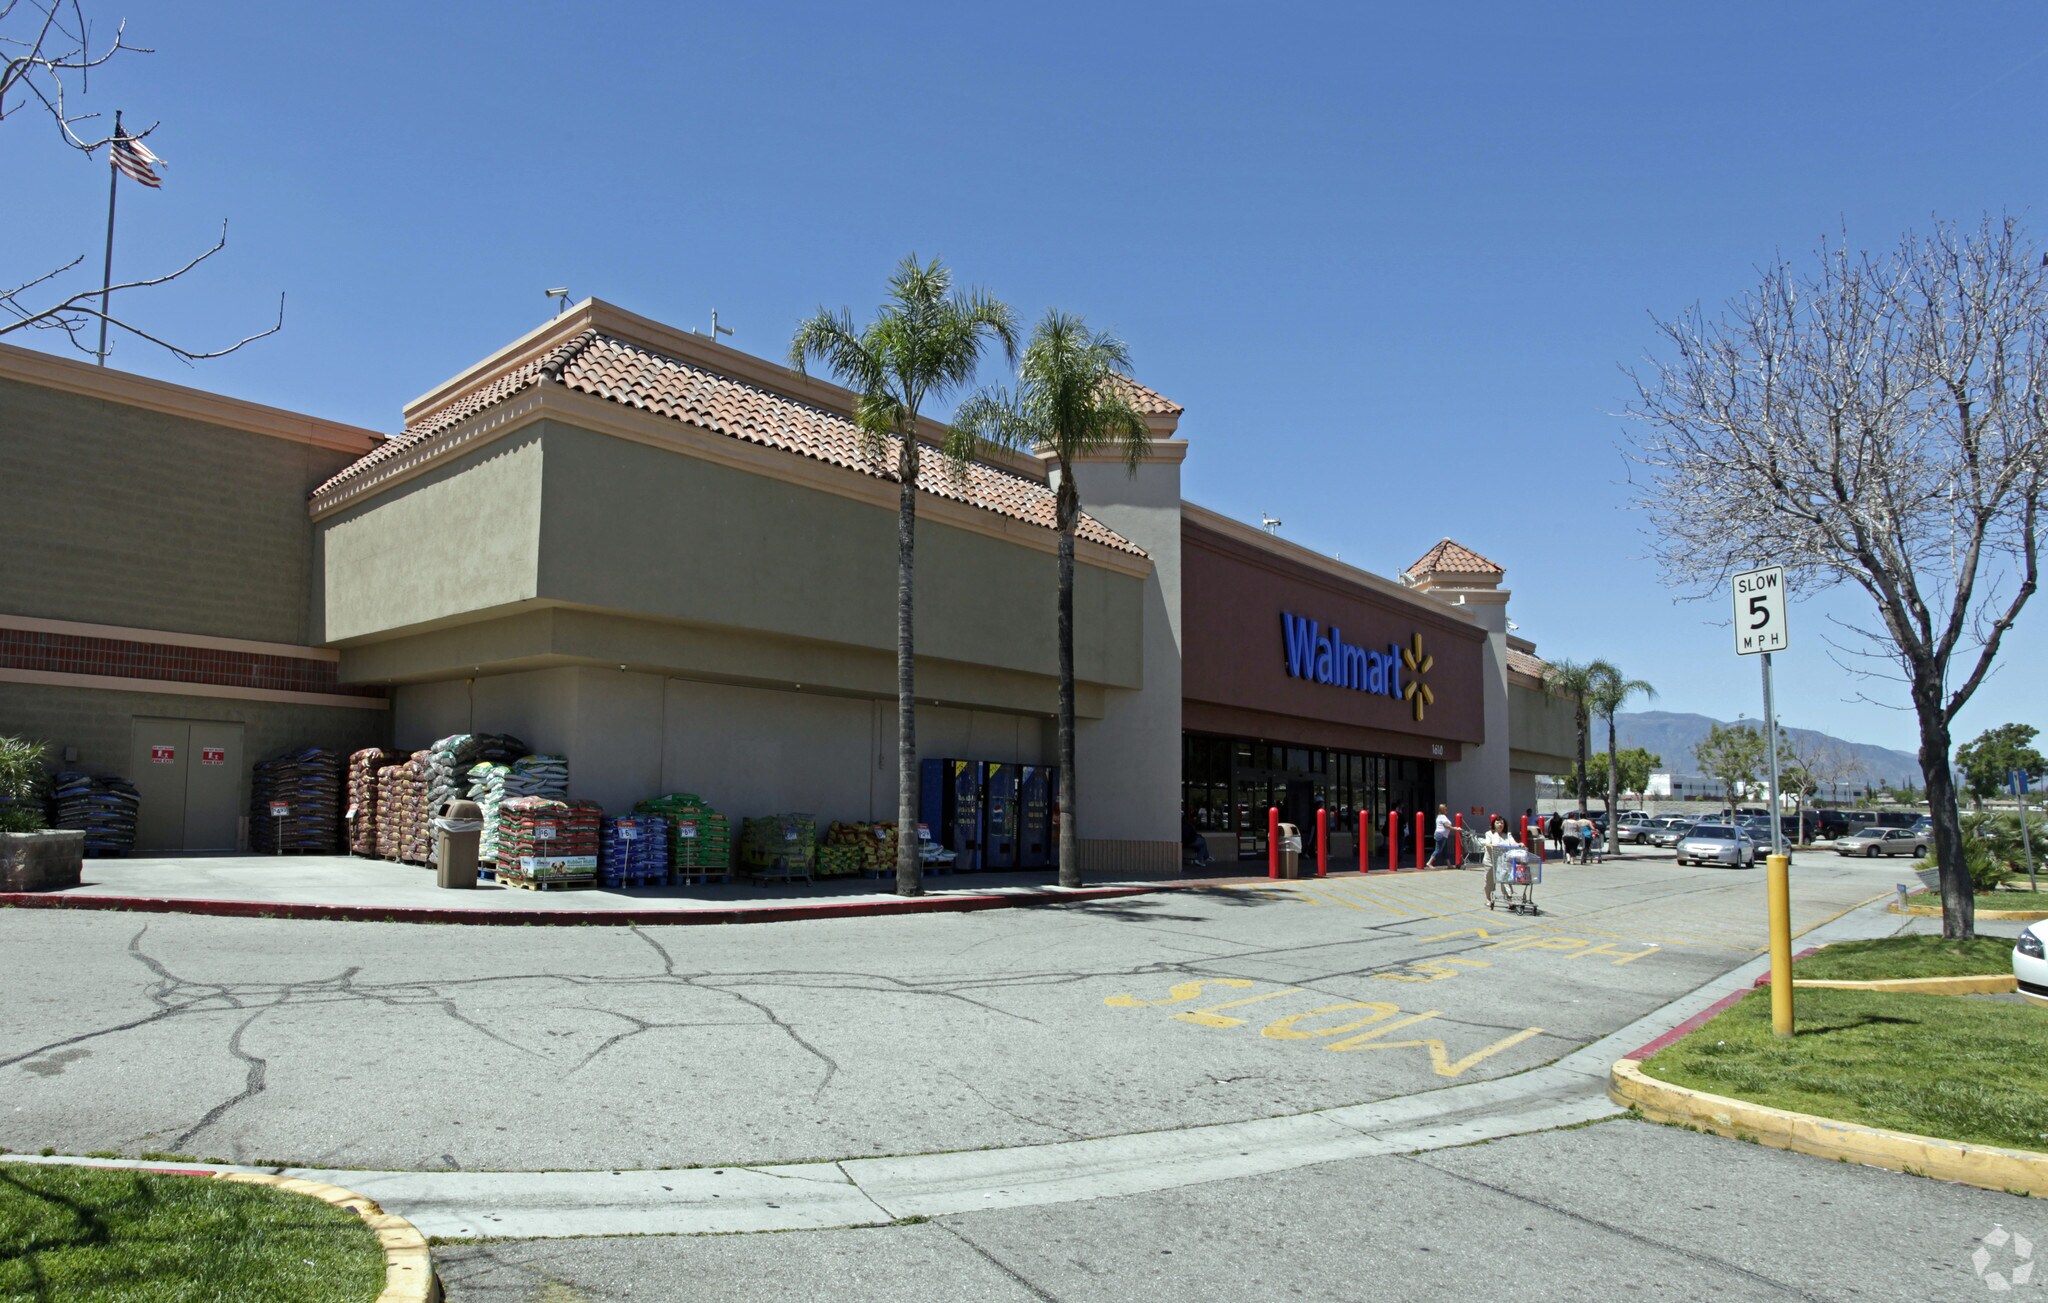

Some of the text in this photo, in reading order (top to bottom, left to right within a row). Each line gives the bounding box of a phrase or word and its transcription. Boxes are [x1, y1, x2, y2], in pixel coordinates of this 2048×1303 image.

[1738, 573, 1777, 593] SLOW
[1749, 595, 1770, 629] 5
[1281, 611, 1402, 700] Walmart
[1421, 928, 1661, 965] MPH
[1372, 957, 1493, 983] 5
[1103, 979, 1544, 1076] SLOW
